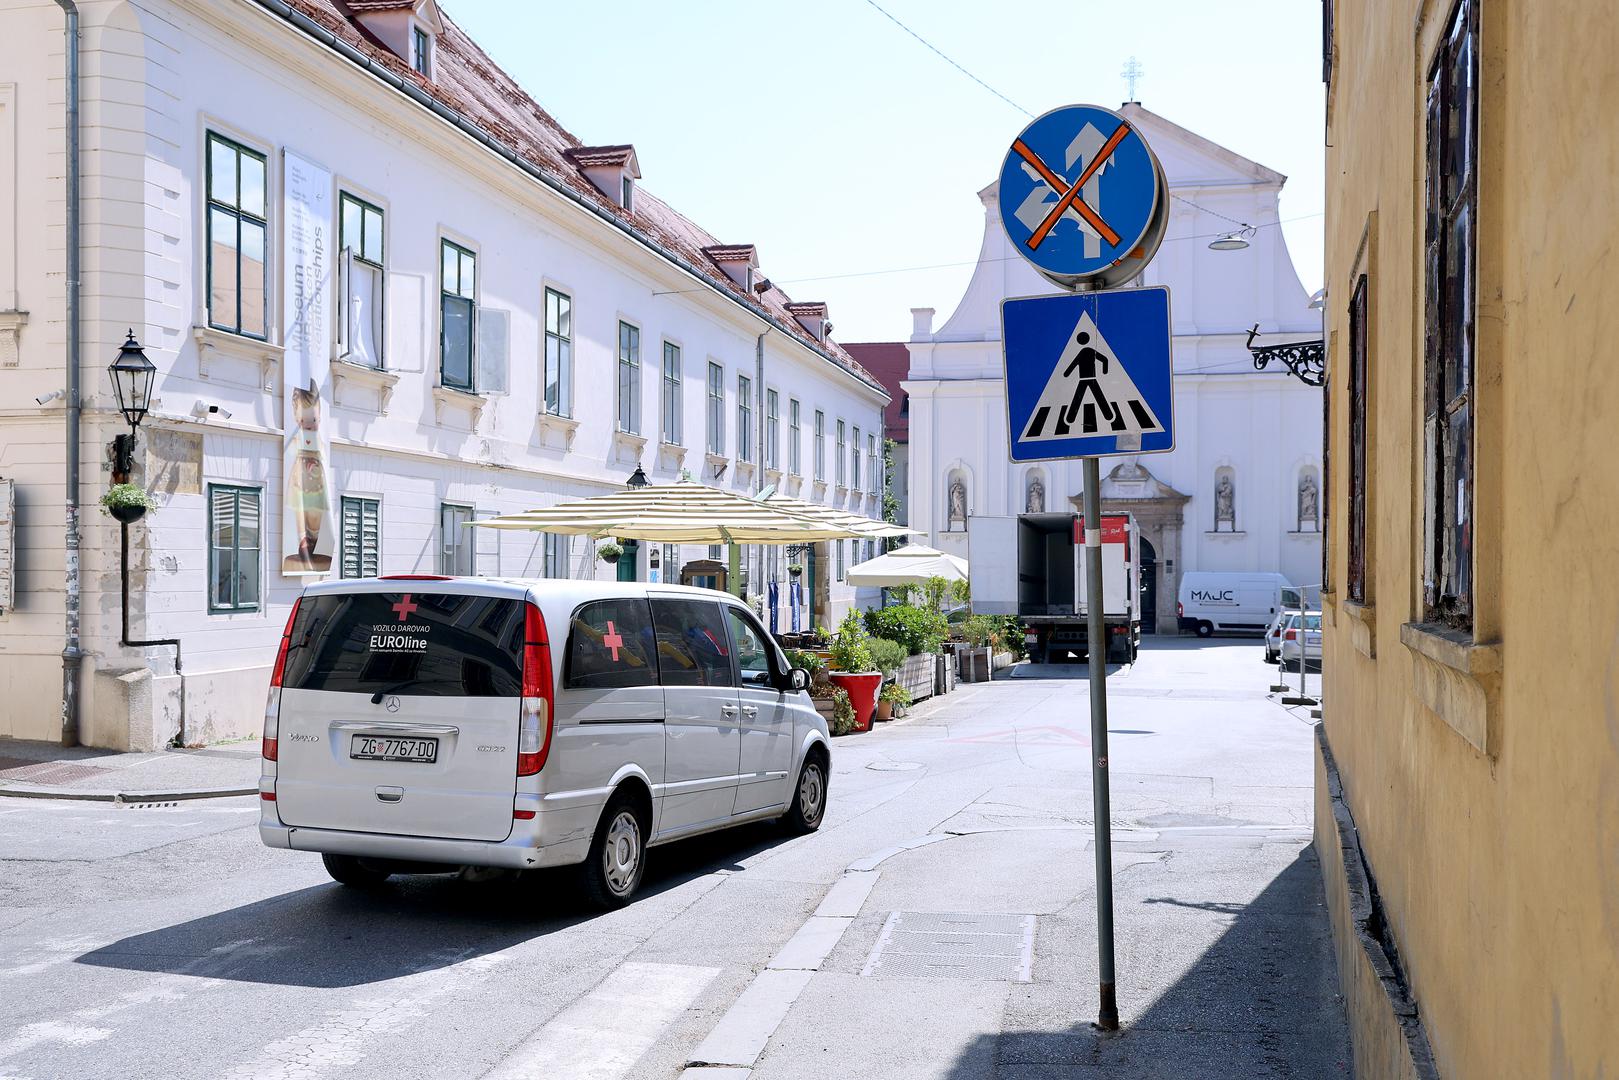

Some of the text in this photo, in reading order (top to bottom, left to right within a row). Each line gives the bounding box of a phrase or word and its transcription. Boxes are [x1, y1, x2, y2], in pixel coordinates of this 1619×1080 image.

[312, 225, 324, 358] Relationships
[291, 264, 303, 353] Museum
[1191, 590, 1233, 601] MAJC
[372, 624, 430, 633] VOZILO DAROVAO
[370, 635, 428, 649] EUROline
[361, 739, 377, 754] ZG
